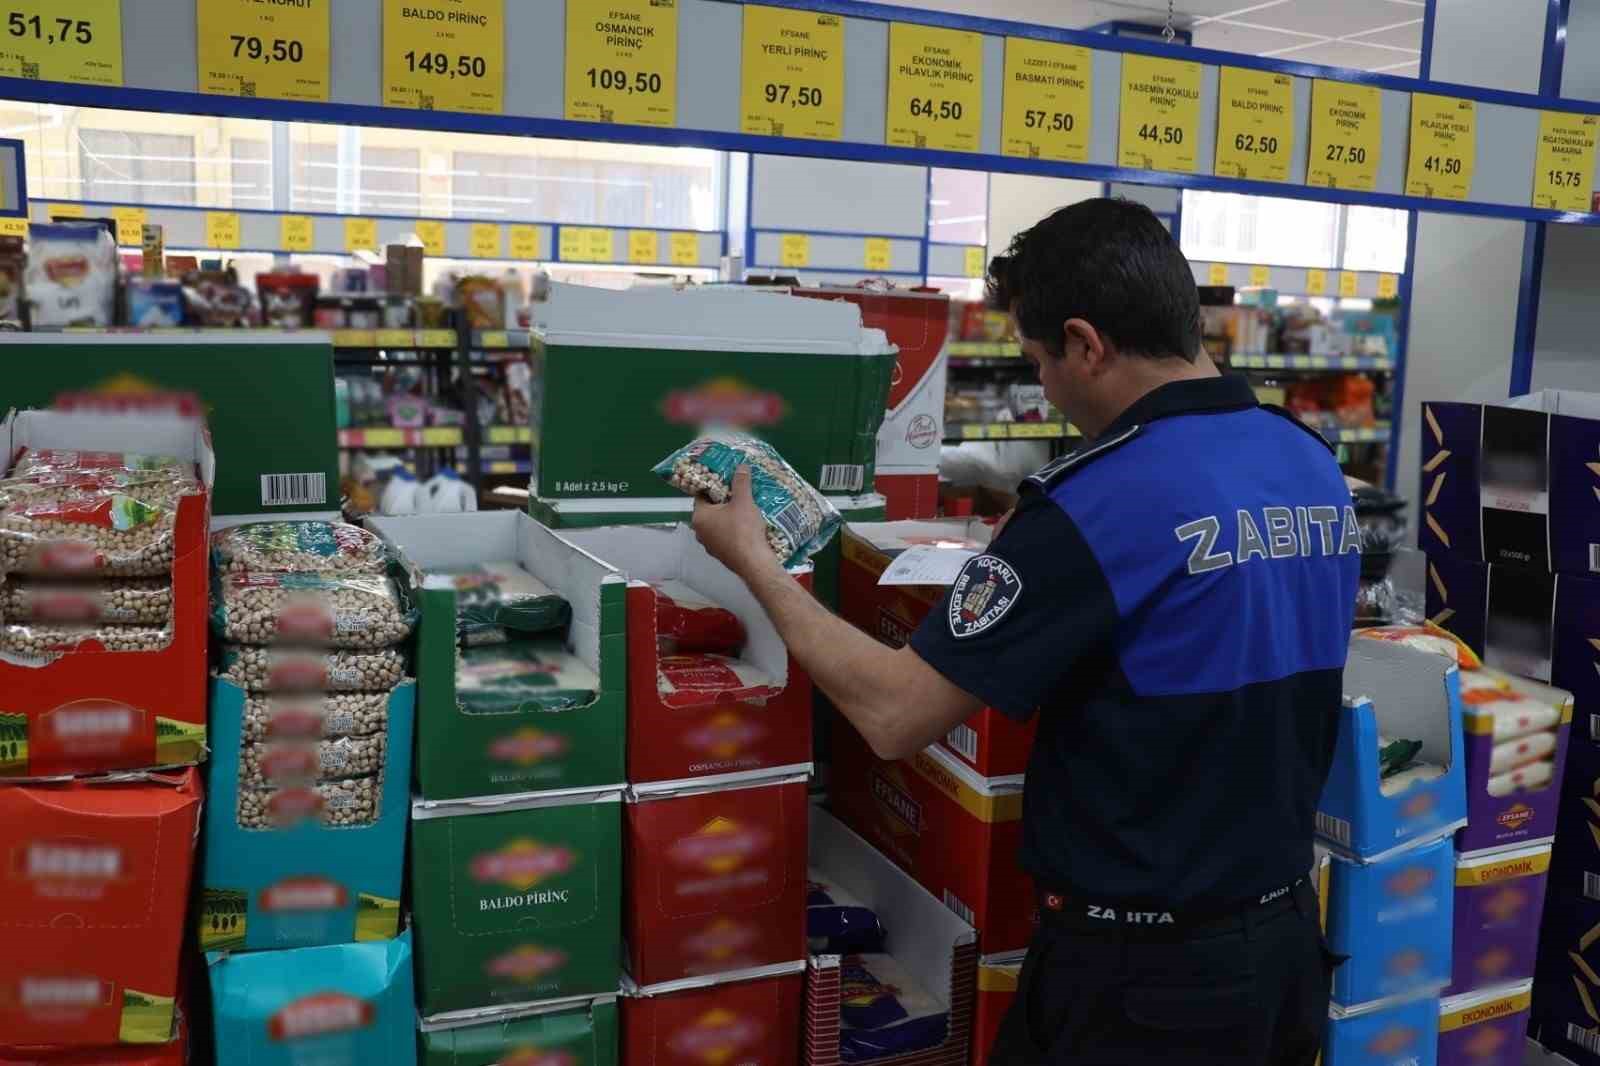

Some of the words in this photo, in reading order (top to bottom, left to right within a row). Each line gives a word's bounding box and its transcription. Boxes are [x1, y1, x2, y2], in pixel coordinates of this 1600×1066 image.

[402, 7, 445, 21] BALDO
[448, 10, 487, 27] PİRİNÇ
[608, 11, 641, 21] EFSANE
[8, 12, 92, 45] 51,75
[595, 22, 655, 37] OSMANCIK
[780, 28, 810, 40] EFSANE
[230, 35, 303, 64] 79,50
[606, 36, 643, 50] PİRİNÇ
[794, 46, 829, 61] PİRİNÇ
[923, 45, 951, 55] EFSANE
[404, 50, 486, 79] 149,50
[912, 55, 963, 70] EKONOMİK
[586, 67, 662, 95] 109,50
[899, 64, 942, 79] PİLAVLIK
[943, 69, 975, 84] PİRİNÇ
[1056, 76, 1086, 90] PİRİNÇ
[764, 83, 823, 108] 97,50
[1165, 87, 1199, 99] KOKULU
[910, 98, 963, 121] 64,50
[1231, 99, 1258, 111] BALDO
[1025, 109, 1074, 133] 57,50
[1138, 124, 1184, 145] 44,50
[1235, 134, 1278, 155] 62,50
[1326, 144, 1366, 164] 27,50
[1424, 155, 1461, 175] 41,50
[1549, 169, 1582, 188] 15,75
[563, 481, 583, 492] Adet
[1174, 505, 1363, 575] ZABITA
[977, 558, 1015, 585] KOÇARLI
[951, 574, 970, 625] BELEDİYE
[964, 596, 1010, 632] ZABITASI
[874, 780, 920, 829] EFSANE
[1480, 860, 1534, 881] EKONOMİK
[480, 895, 523, 911] BALDO
[526, 887, 569, 903] PİRİNÇ
[1461, 1000, 1514, 1025] EKONOMİK
